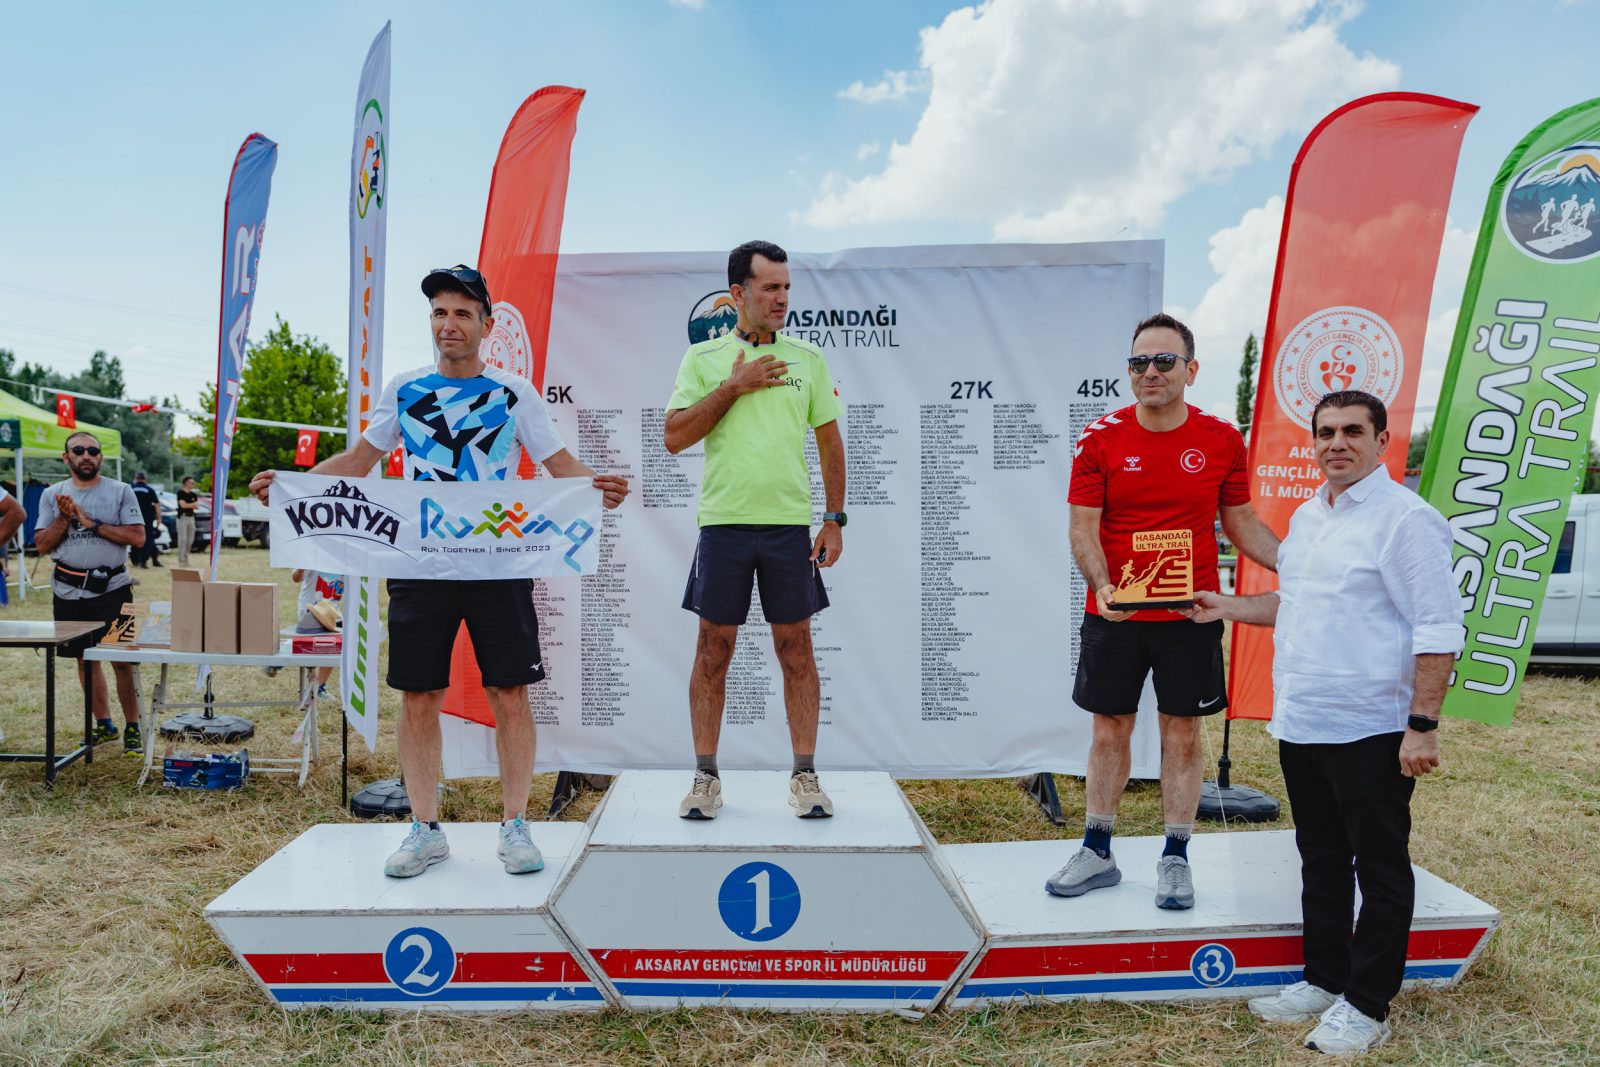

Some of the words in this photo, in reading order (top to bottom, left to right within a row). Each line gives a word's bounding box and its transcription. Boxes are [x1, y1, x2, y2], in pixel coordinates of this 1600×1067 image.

[786, 304, 897, 327] ASANDAĞI
[841, 329, 900, 347] TRAIL
[950, 380, 993, 399] 27K
[1077, 378, 1120, 398] 45K
[1256, 464, 1321, 481] GENÇLİK
[1260, 481, 1273, 497] İL
[1464, 499, 1561, 696] ULTRA
[1518, 311, 1600, 479] TRAIL
[284, 500, 400, 545] KONYA
[1136, 531, 1191, 542] HASANDAĞI
[746, 869, 772, 935] 1
[400, 934, 439, 987] 2
[634, 958, 700, 972] AKSARAY
[764, 959, 782, 972] VE
[785, 959, 822, 972] SPOR
[825, 957, 838, 972] İL
[841, 957, 927, 973] MÜDÜRLÜĞÜ
[1199, 948, 1226, 982] 3
